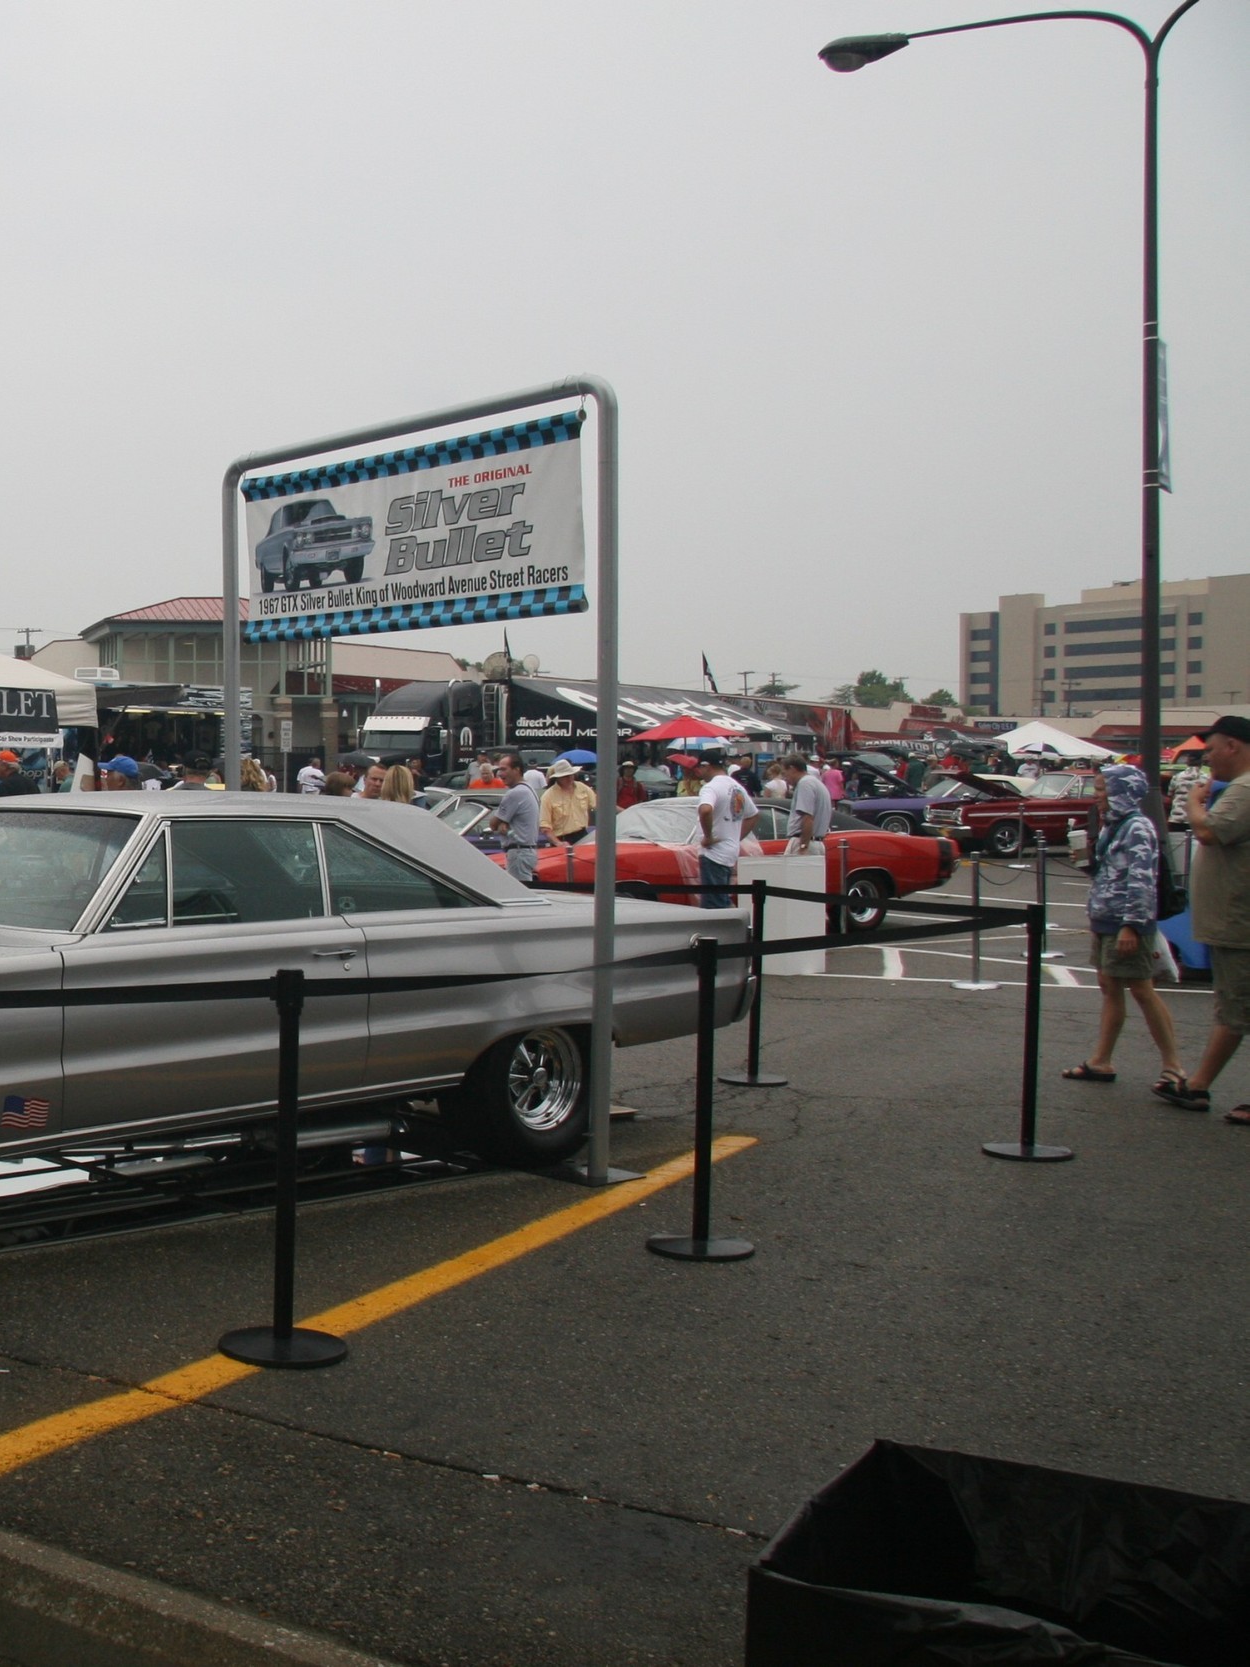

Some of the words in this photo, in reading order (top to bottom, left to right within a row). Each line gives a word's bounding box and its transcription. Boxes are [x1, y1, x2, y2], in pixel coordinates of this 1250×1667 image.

[448, 475, 470, 488] THE
[474, 464, 533, 483] ORIGINAL
[385, 482, 527, 536] Silver
[383, 520, 534, 576] Bullet
[259, 597, 280, 615] 1967
[280, 594, 299, 613] GTX
[300, 591, 326, 611] Silver
[327, 586, 355, 608] Bullet
[356, 583, 378, 607] King
[379, 583, 390, 602] of
[391, 576, 445, 602] Woodward
[448, 575, 488, 595] Avenue
[490, 566, 526, 590] Street
[527, 564, 569, 587] Racers
[515, 727, 567, 737] connection
[516, 717, 543, 727] direct
